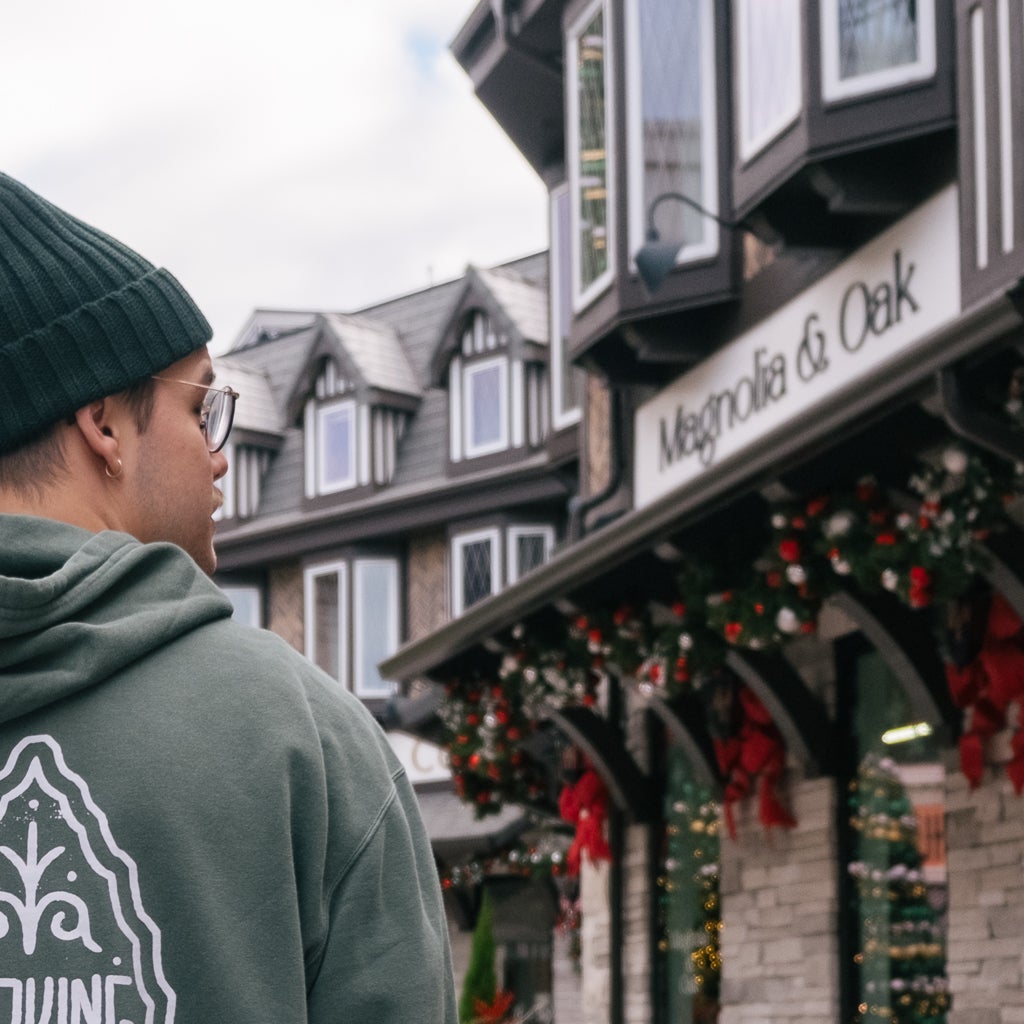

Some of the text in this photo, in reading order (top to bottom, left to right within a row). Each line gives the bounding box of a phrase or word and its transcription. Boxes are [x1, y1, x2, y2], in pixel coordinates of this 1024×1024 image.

[659, 249, 921, 474] Magnolia & Oak
